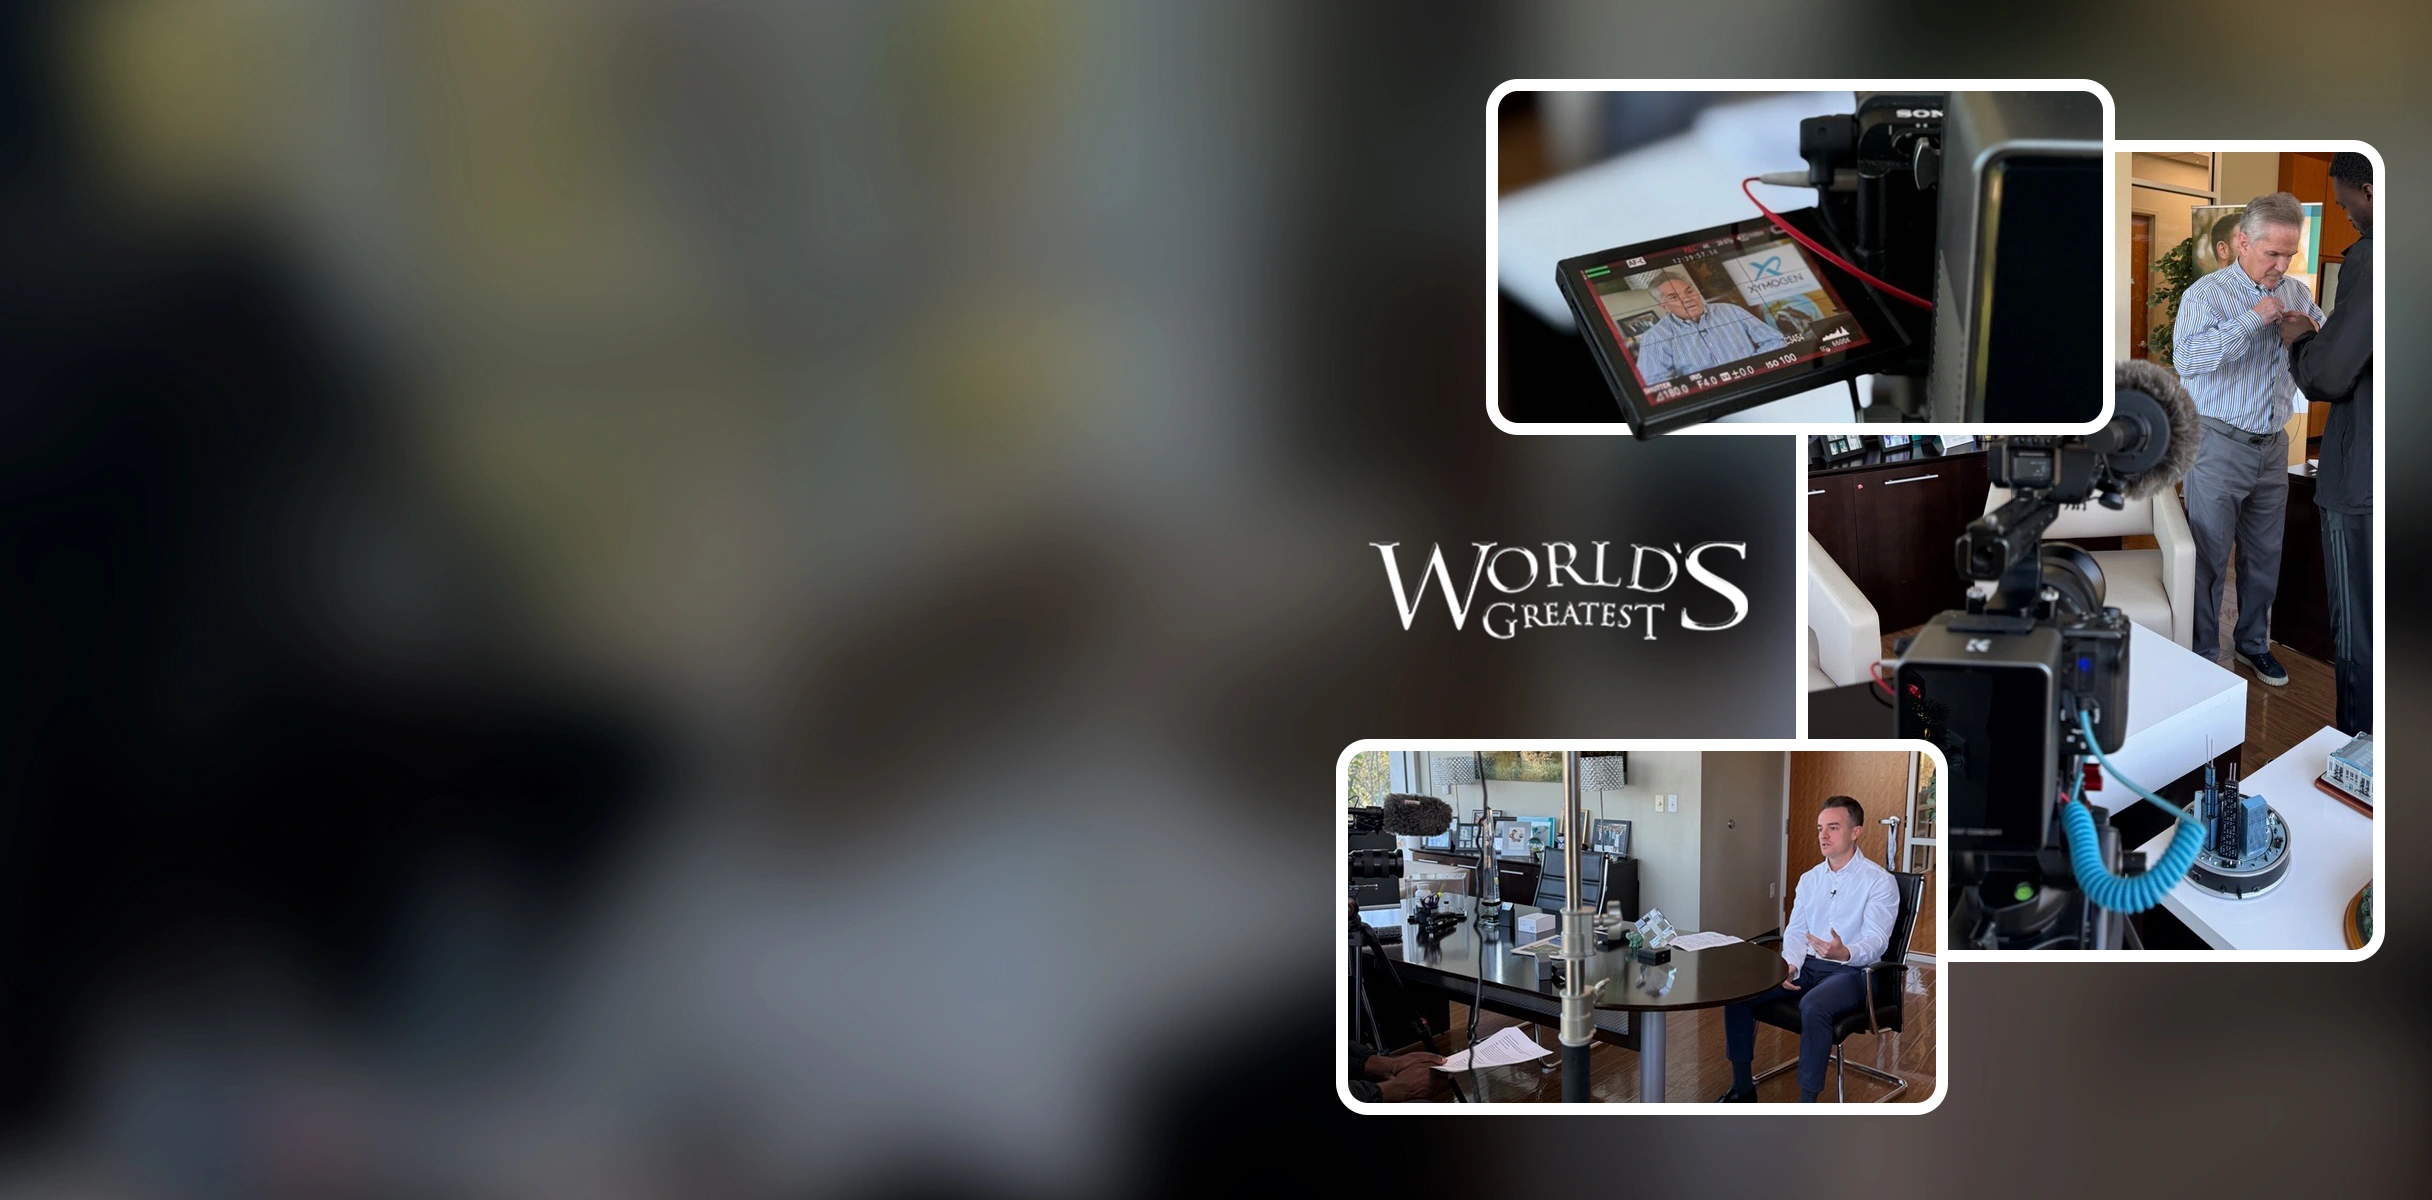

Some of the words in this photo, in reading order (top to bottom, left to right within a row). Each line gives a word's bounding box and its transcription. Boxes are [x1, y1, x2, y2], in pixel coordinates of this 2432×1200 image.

[1627, 257, 1646, 268] AF-C
[1748, 273, 1804, 293] XYMOGEN
[1765, 359, 1779, 369] ISO
[1779, 352, 1797, 365] 100
[1697, 375, 1718, 389] F4.0
